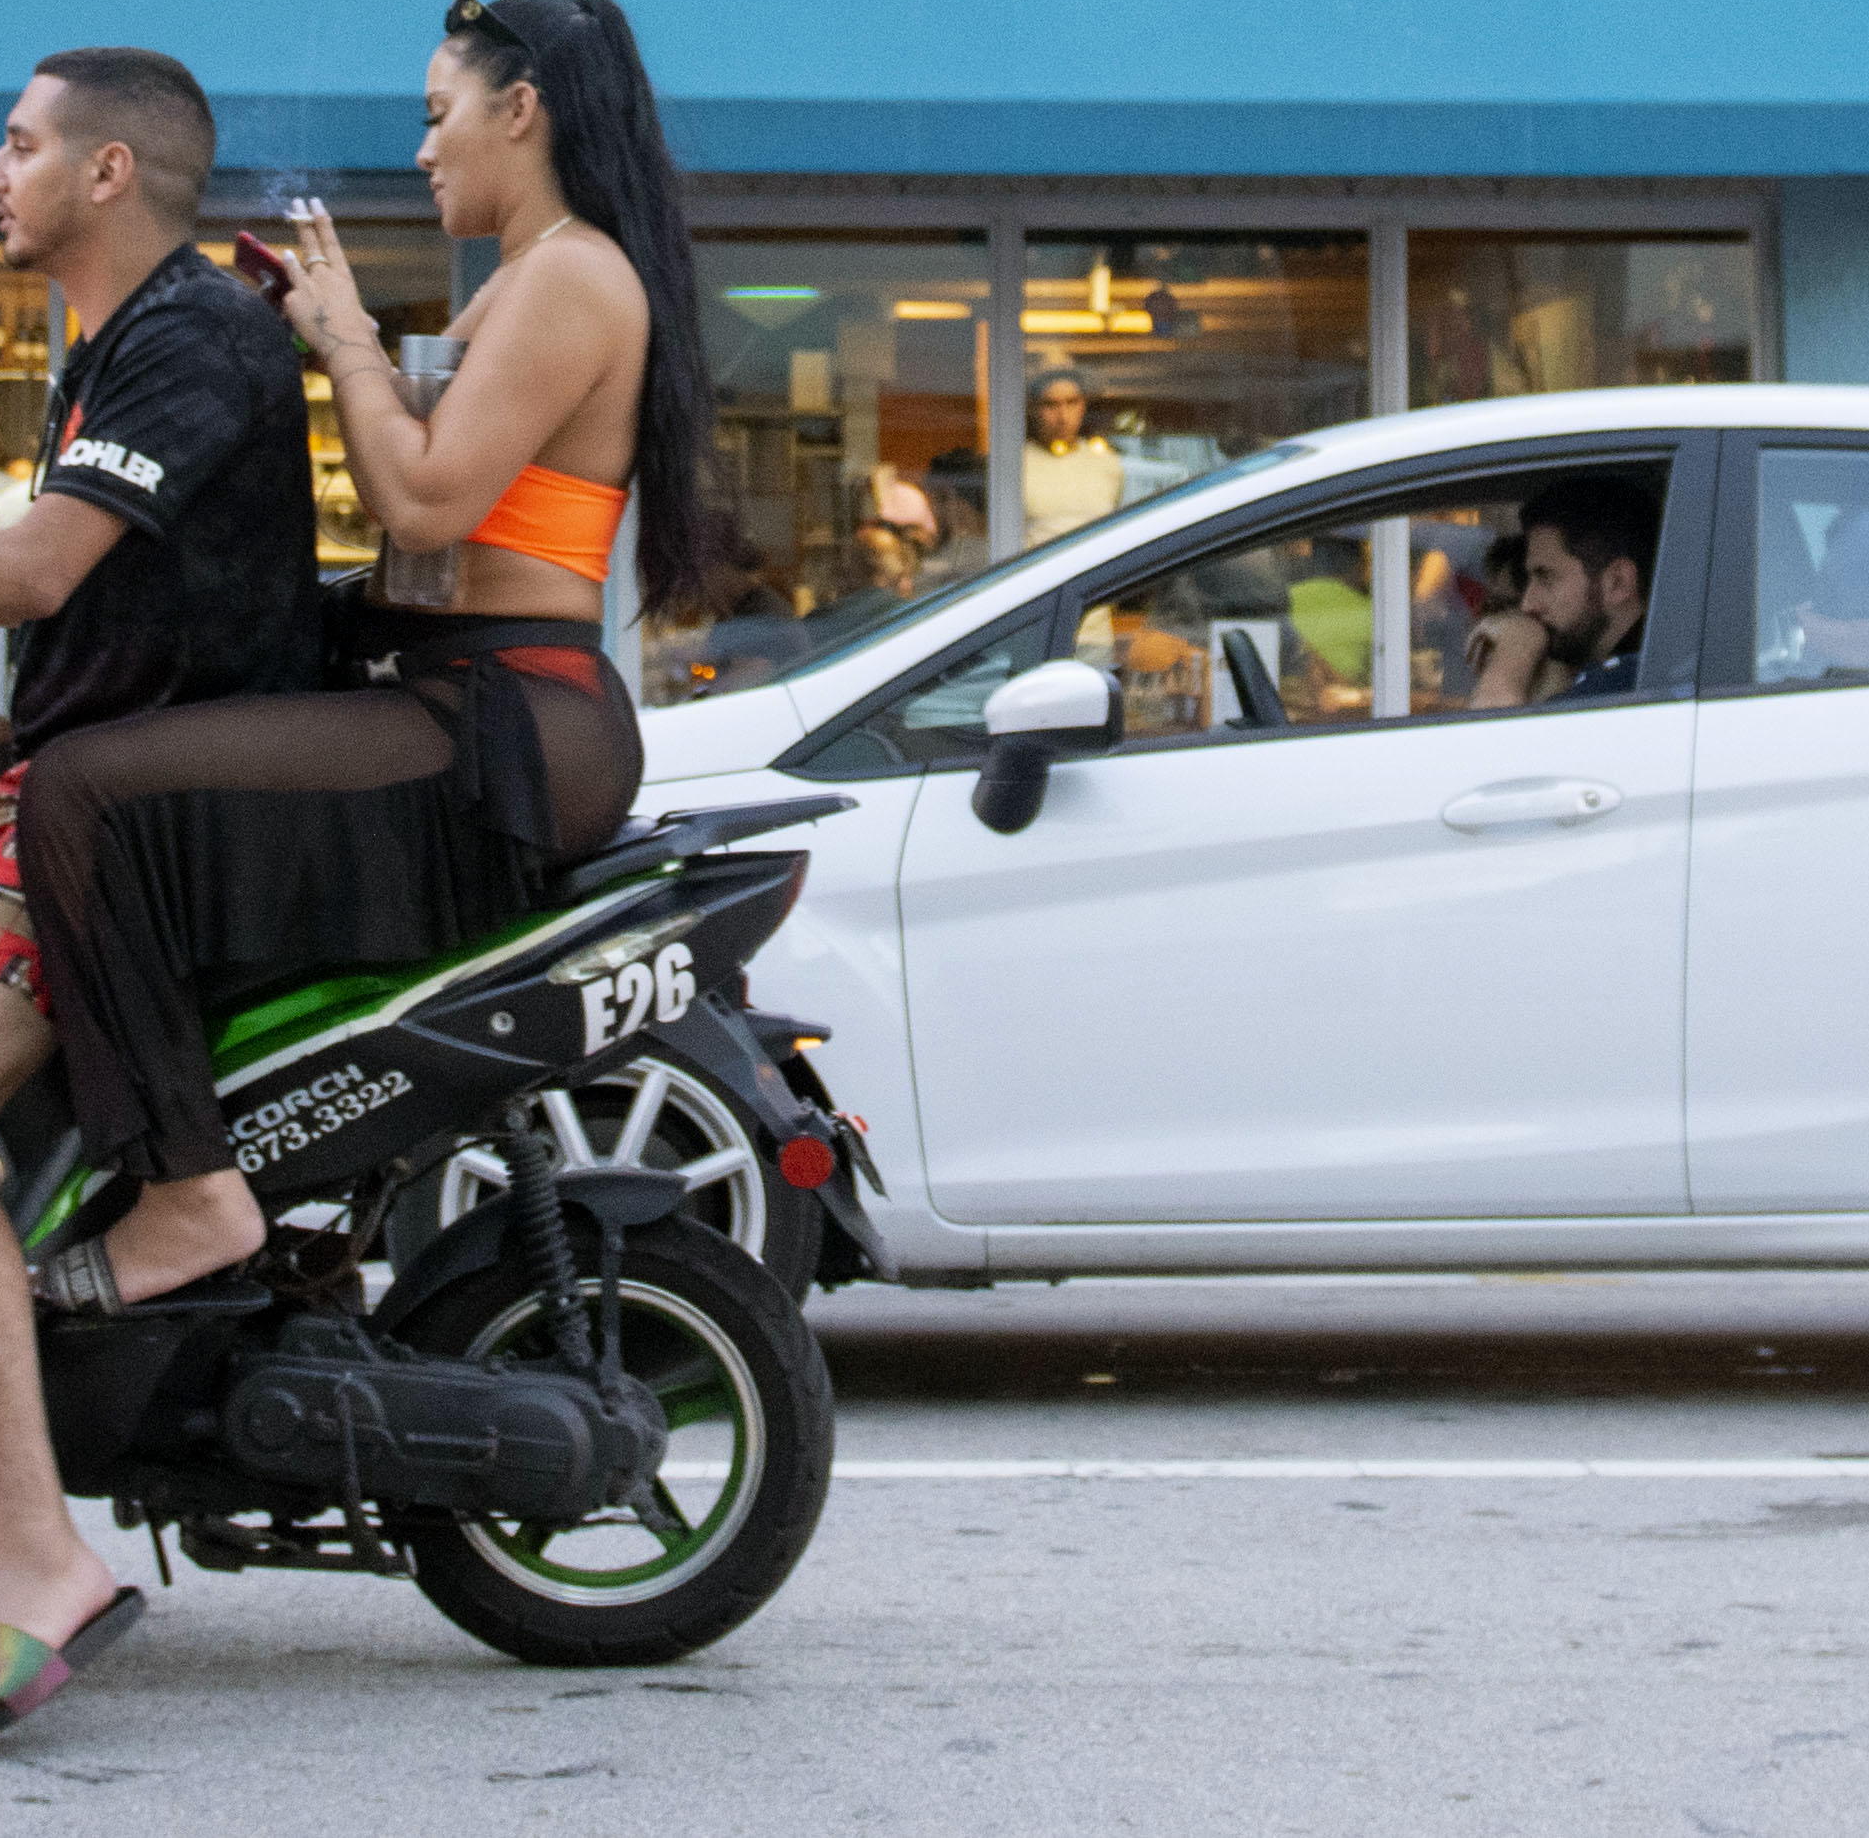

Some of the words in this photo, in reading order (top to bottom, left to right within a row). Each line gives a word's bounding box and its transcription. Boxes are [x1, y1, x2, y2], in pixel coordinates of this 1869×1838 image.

[58, 438, 164, 495] OHLER
[581, 943, 696, 1057] E26
[225, 1064, 364, 1145] CORCH
[236, 1071, 413, 1173] 673.3322
